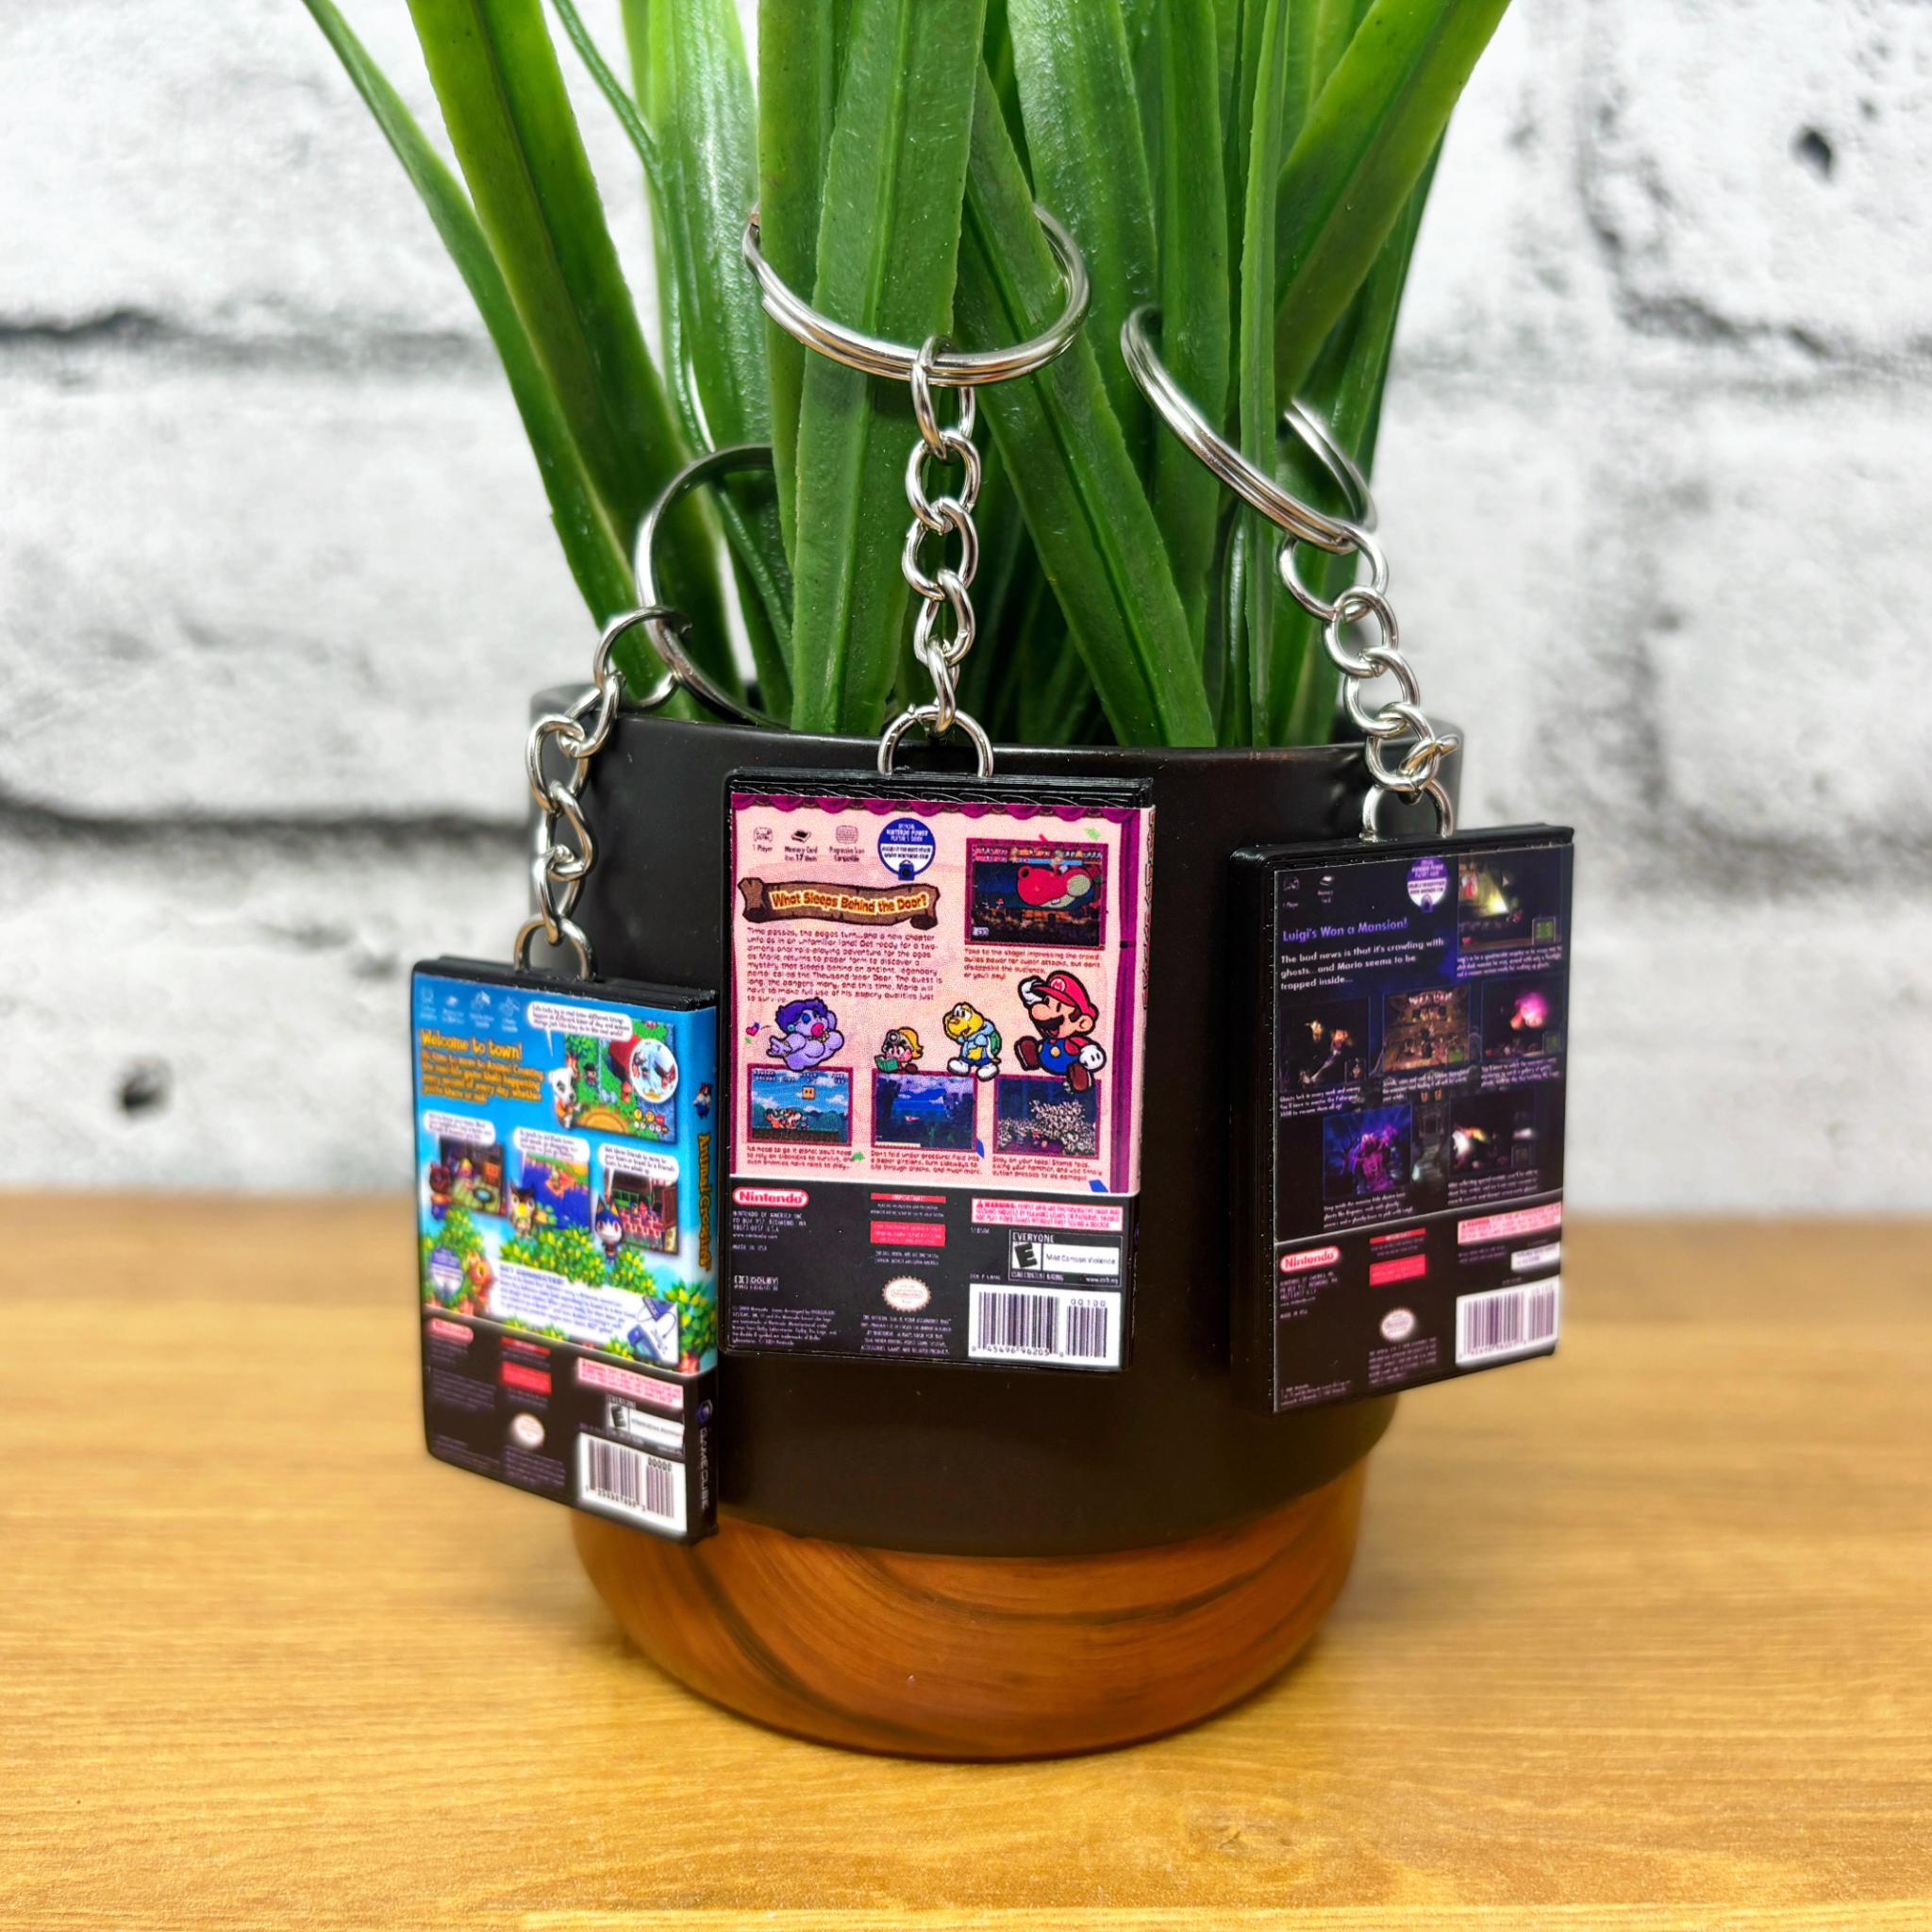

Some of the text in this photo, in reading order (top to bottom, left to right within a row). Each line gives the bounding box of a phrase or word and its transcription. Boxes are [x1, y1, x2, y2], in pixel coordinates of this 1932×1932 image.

[773, 891, 927, 912] What Sleeps Behind the Door?
[1283, 928, 1317, 943] Luigi's
[1320, 925, 1344, 937] Won
[1357, 917, 1408, 933] Mansion!
[1281, 955, 1296, 964] The
[1300, 952, 1317, 961] bad
[1353, 947, 1371, 956] that
[1374, 944, 1385, 953] it's
[1387, 941, 1424, 952] crawling
[1425, 938, 1444, 947] with
[1338, 961, 1363, 971] Mario
[1365, 958, 1391, 968] seems
[1394, 956, 1403, 964] to
[1406, 955, 1416, 963] be
[1280, 976, 1316, 991] trapped
[421, 1027, 523, 1060] Welcome to town!
[698, 1133, 712, 1272] Animal Crossing
[739, 1191, 803, 1204] Nintendo
[1012, 1232, 1055, 1243] EVERYONE
[1014, 1242, 1038, 1268] E
[1046, 1253, 1060, 1261] Mild
[1088, 1257, 1116, 1265] Violence
[1285, 1251, 1334, 1268] Nintendo
